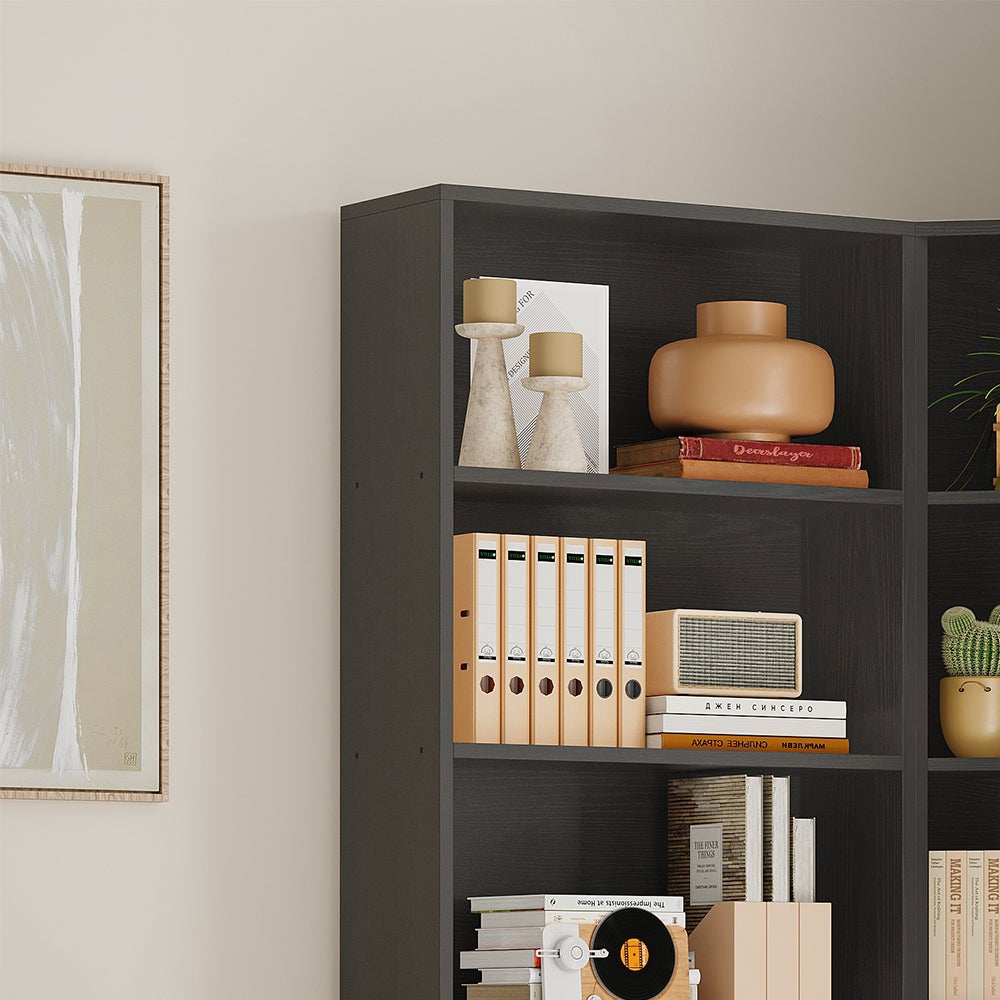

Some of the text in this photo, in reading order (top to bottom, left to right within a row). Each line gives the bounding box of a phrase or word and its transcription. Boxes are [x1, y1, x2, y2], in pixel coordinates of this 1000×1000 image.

[518, 290, 535, 308] FOR
[508, 351, 531, 378] DESIGN
[705, 702, 814, 713] ДЖЕН СИНСЕРО
[950, 858, 962, 900] MAKING
[988, 858, 1000, 900] MAKING
[577, 898, 595, 906] Home
[605, 899, 652, 908] Impressionists
[653, 901, 665, 909] The
[950, 903, 962, 915] IT
[988, 903, 1000, 915] IT
